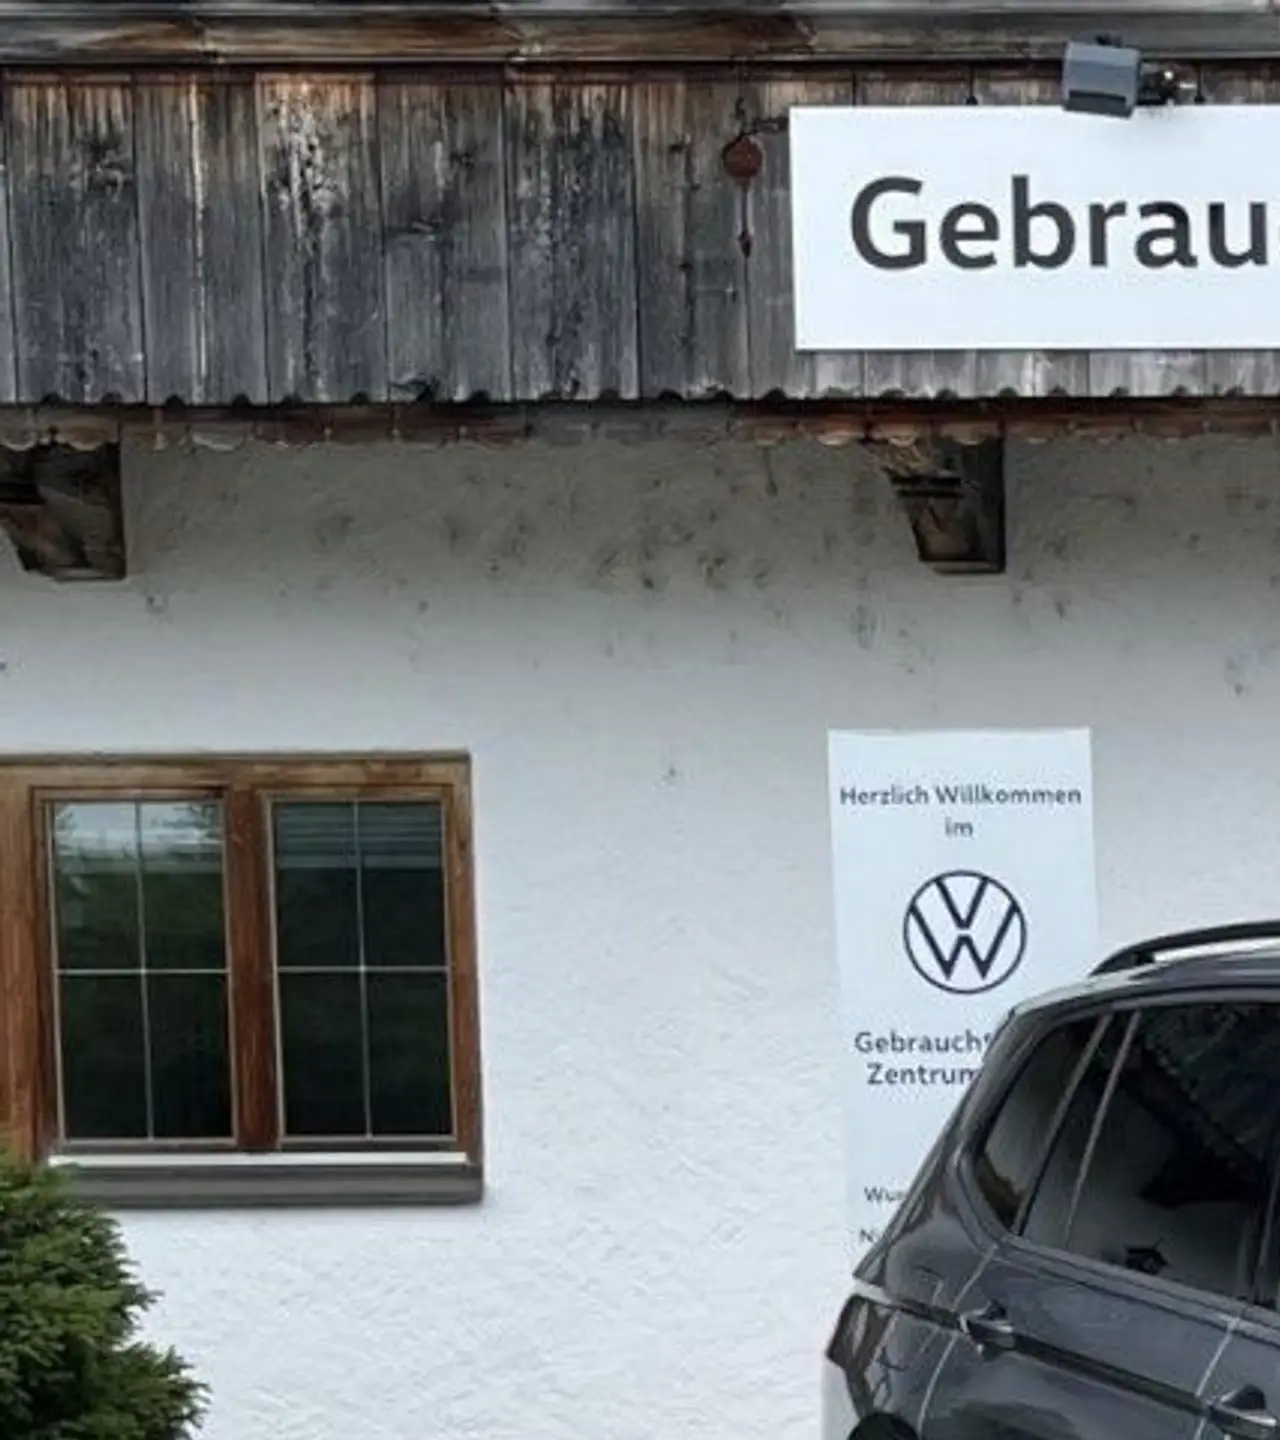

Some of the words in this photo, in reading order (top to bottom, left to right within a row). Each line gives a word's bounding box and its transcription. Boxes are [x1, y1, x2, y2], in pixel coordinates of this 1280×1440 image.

[840, 784, 930, 806] Herzlich
[935, 784, 1082, 806] Willkommen
[945, 818, 974, 837] im
